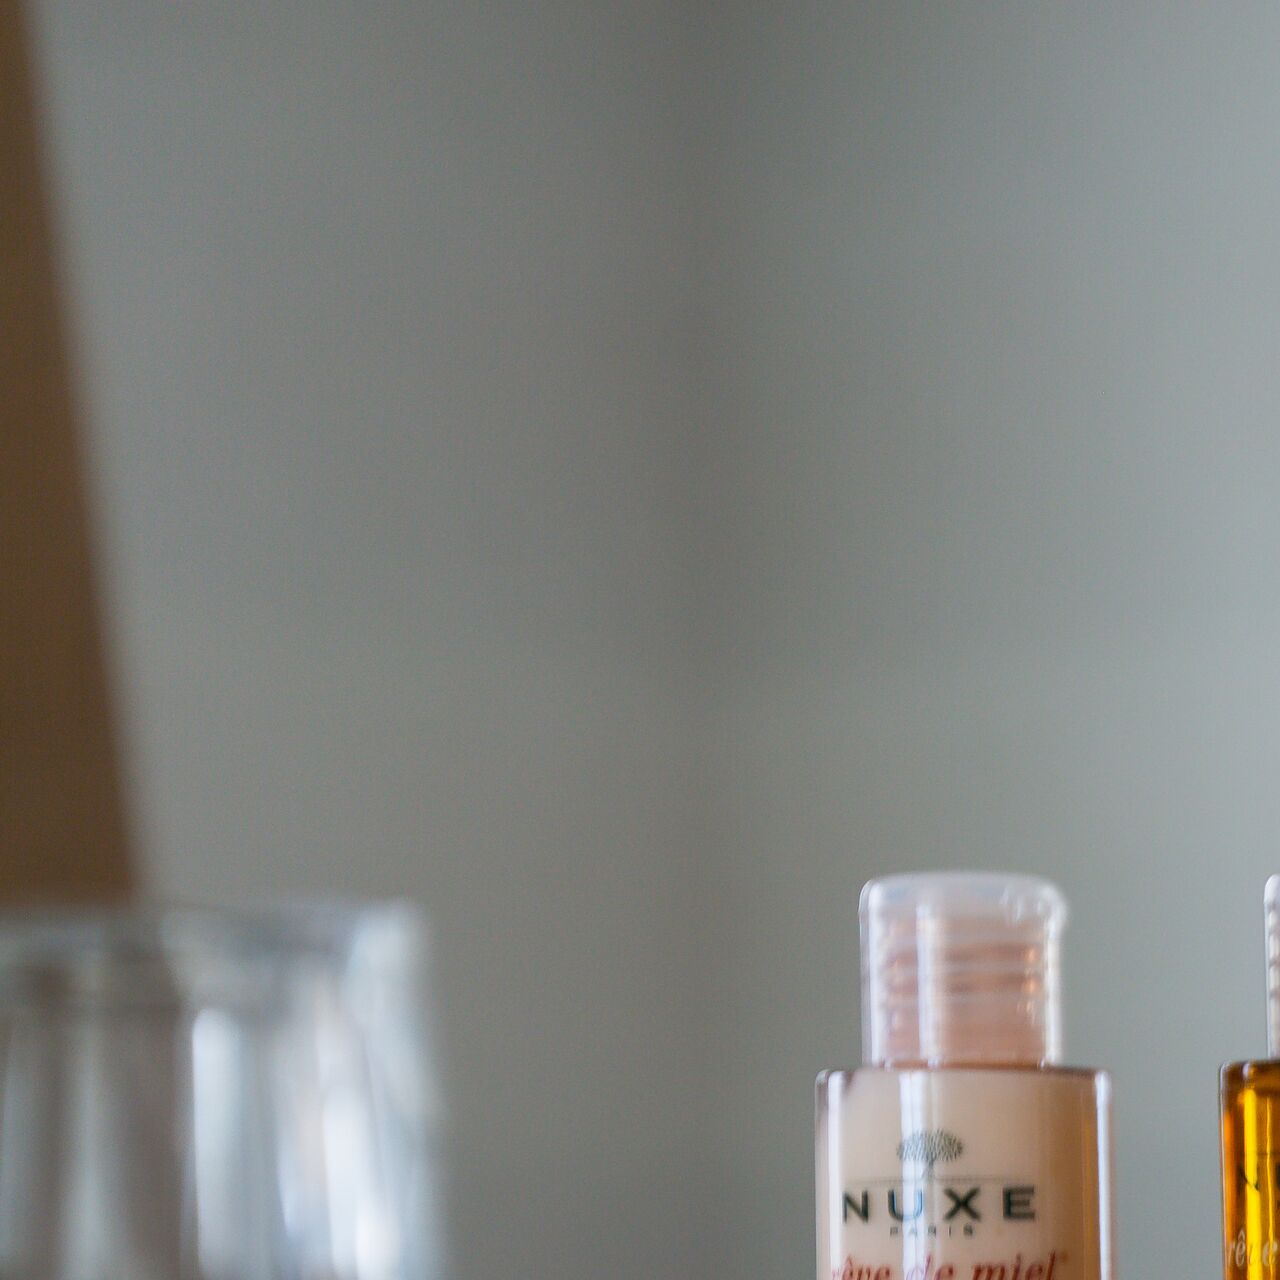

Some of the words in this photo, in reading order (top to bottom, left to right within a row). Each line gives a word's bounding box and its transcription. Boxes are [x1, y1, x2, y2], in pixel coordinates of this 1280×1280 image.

[842, 1184, 1036, 1224] NUXE
[890, 1224, 974, 1237] PARIS
[1228, 1229, 1278, 1268] rêe
